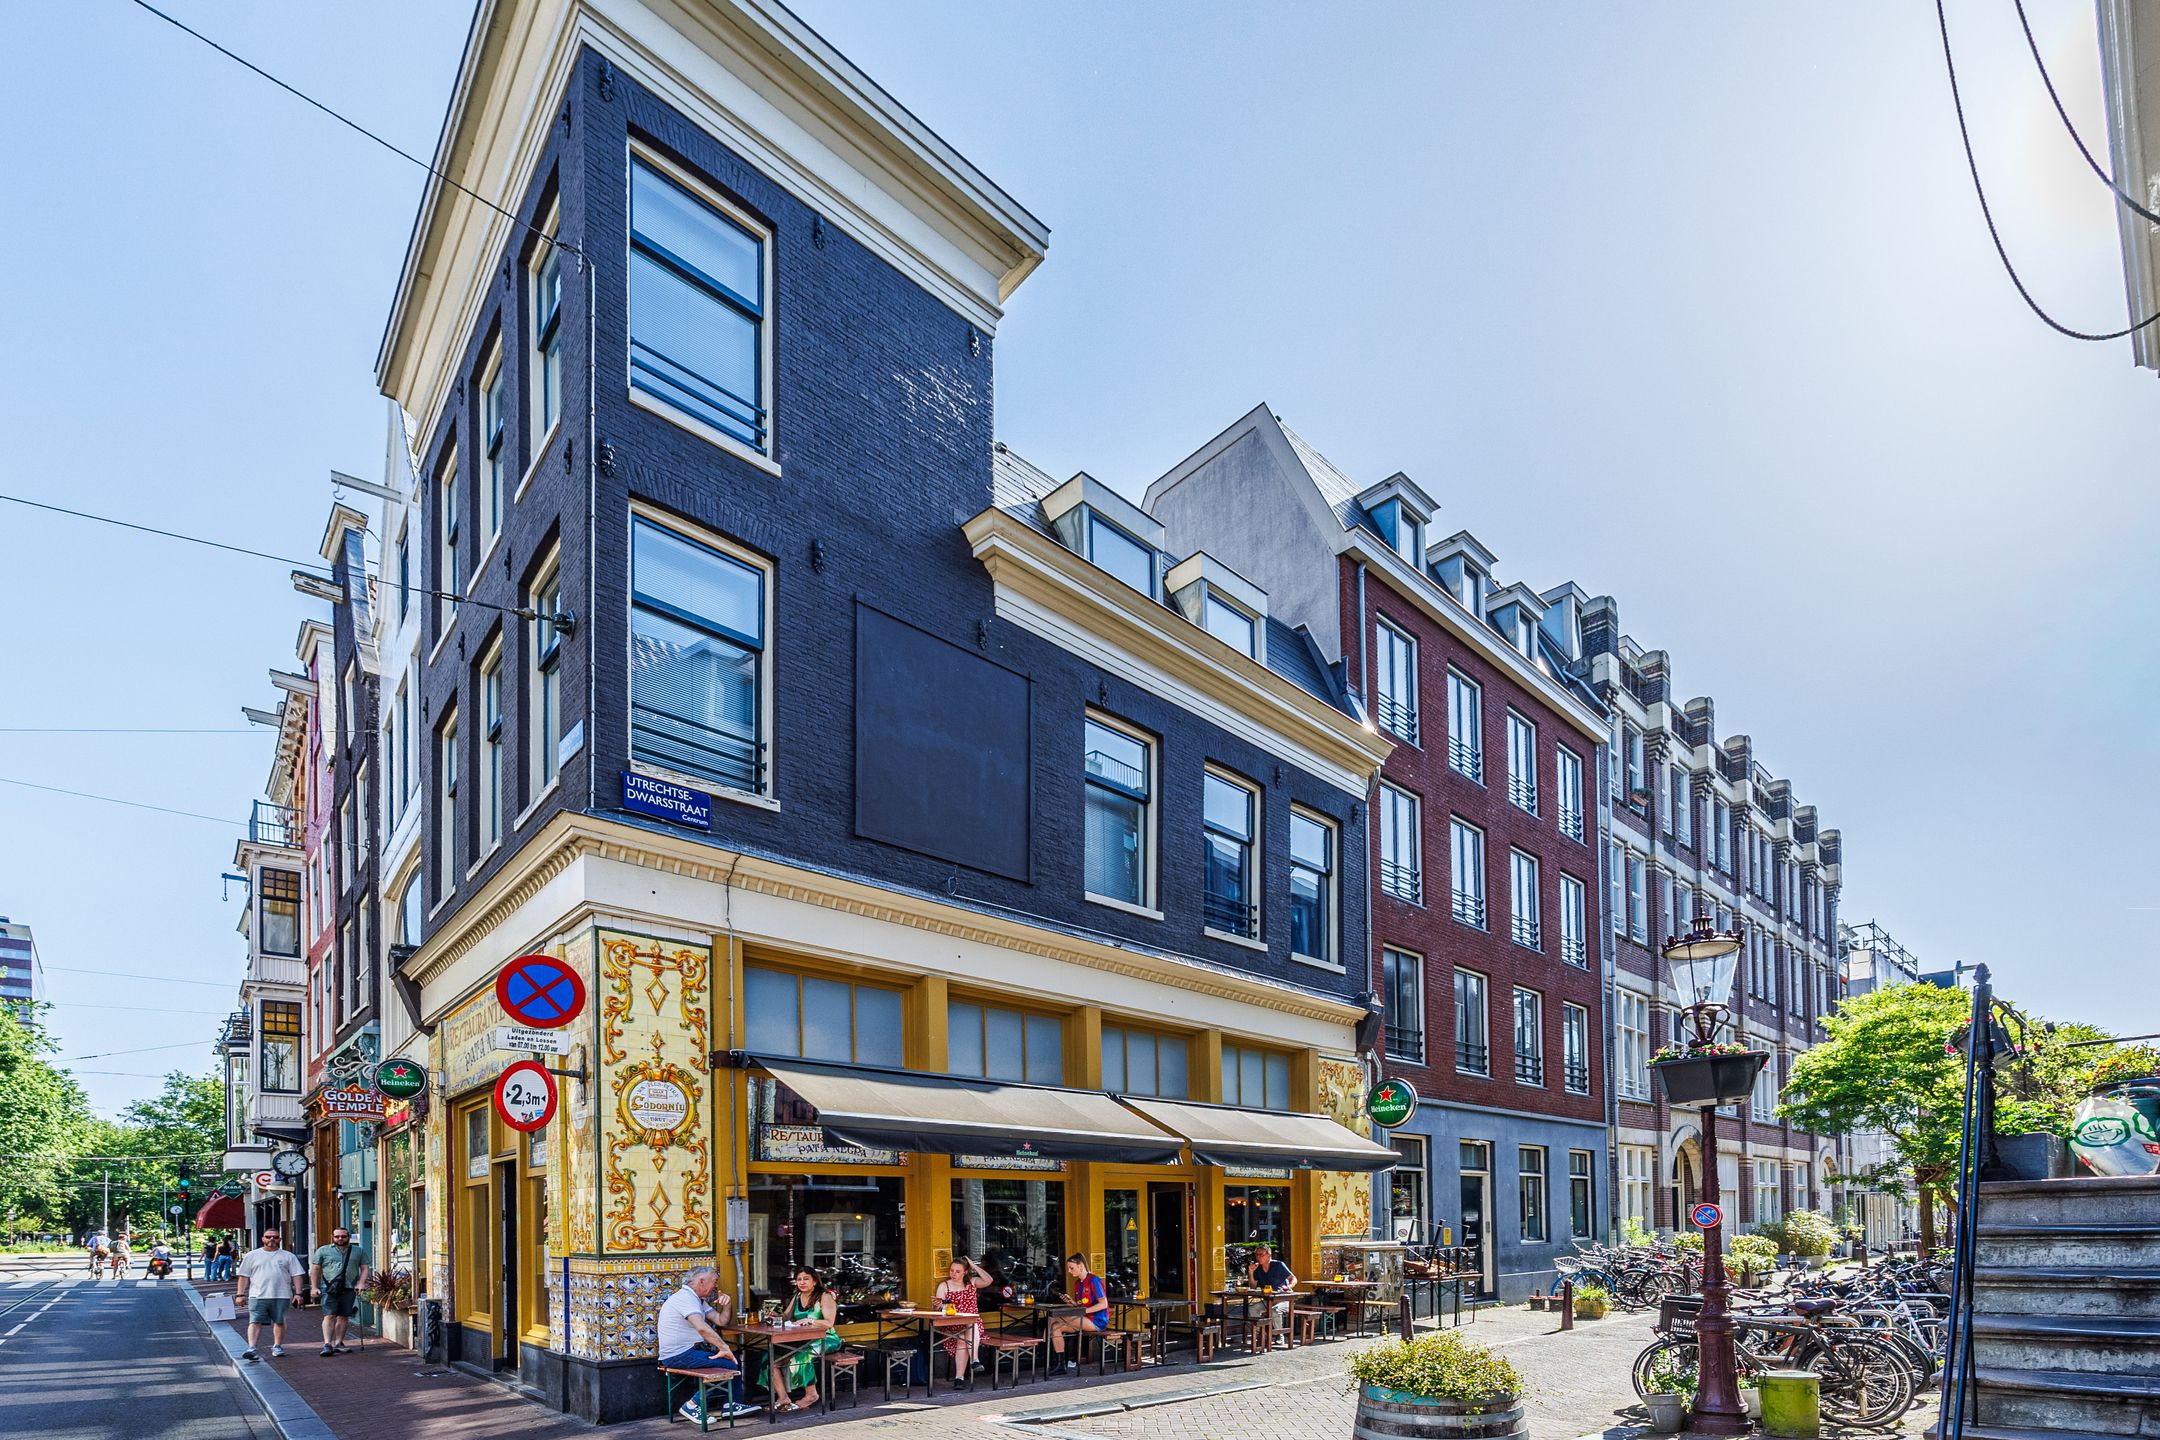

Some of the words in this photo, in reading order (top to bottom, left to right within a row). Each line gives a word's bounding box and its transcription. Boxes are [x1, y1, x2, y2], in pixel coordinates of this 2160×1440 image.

[626, 775, 693, 800] UTRECHTSE-
[627, 788, 708, 817] DWARSSTRAAT
[681, 814, 709, 826] Centrum
[507, 1034, 526, 1042] Laden
[511, 1027, 554, 1037] Uitgezonderd
[381, 1079, 420, 1087] Heineken
[324, 1089, 383, 1103] GOLDEN
[510, 1083, 541, 1107] 2,3m
[326, 1101, 384, 1113] TEMPLE
[1371, 1103, 1407, 1113] Heineken
[798, 1143, 829, 1155] PATA
[833, 1146, 867, 1158] NEGRA
